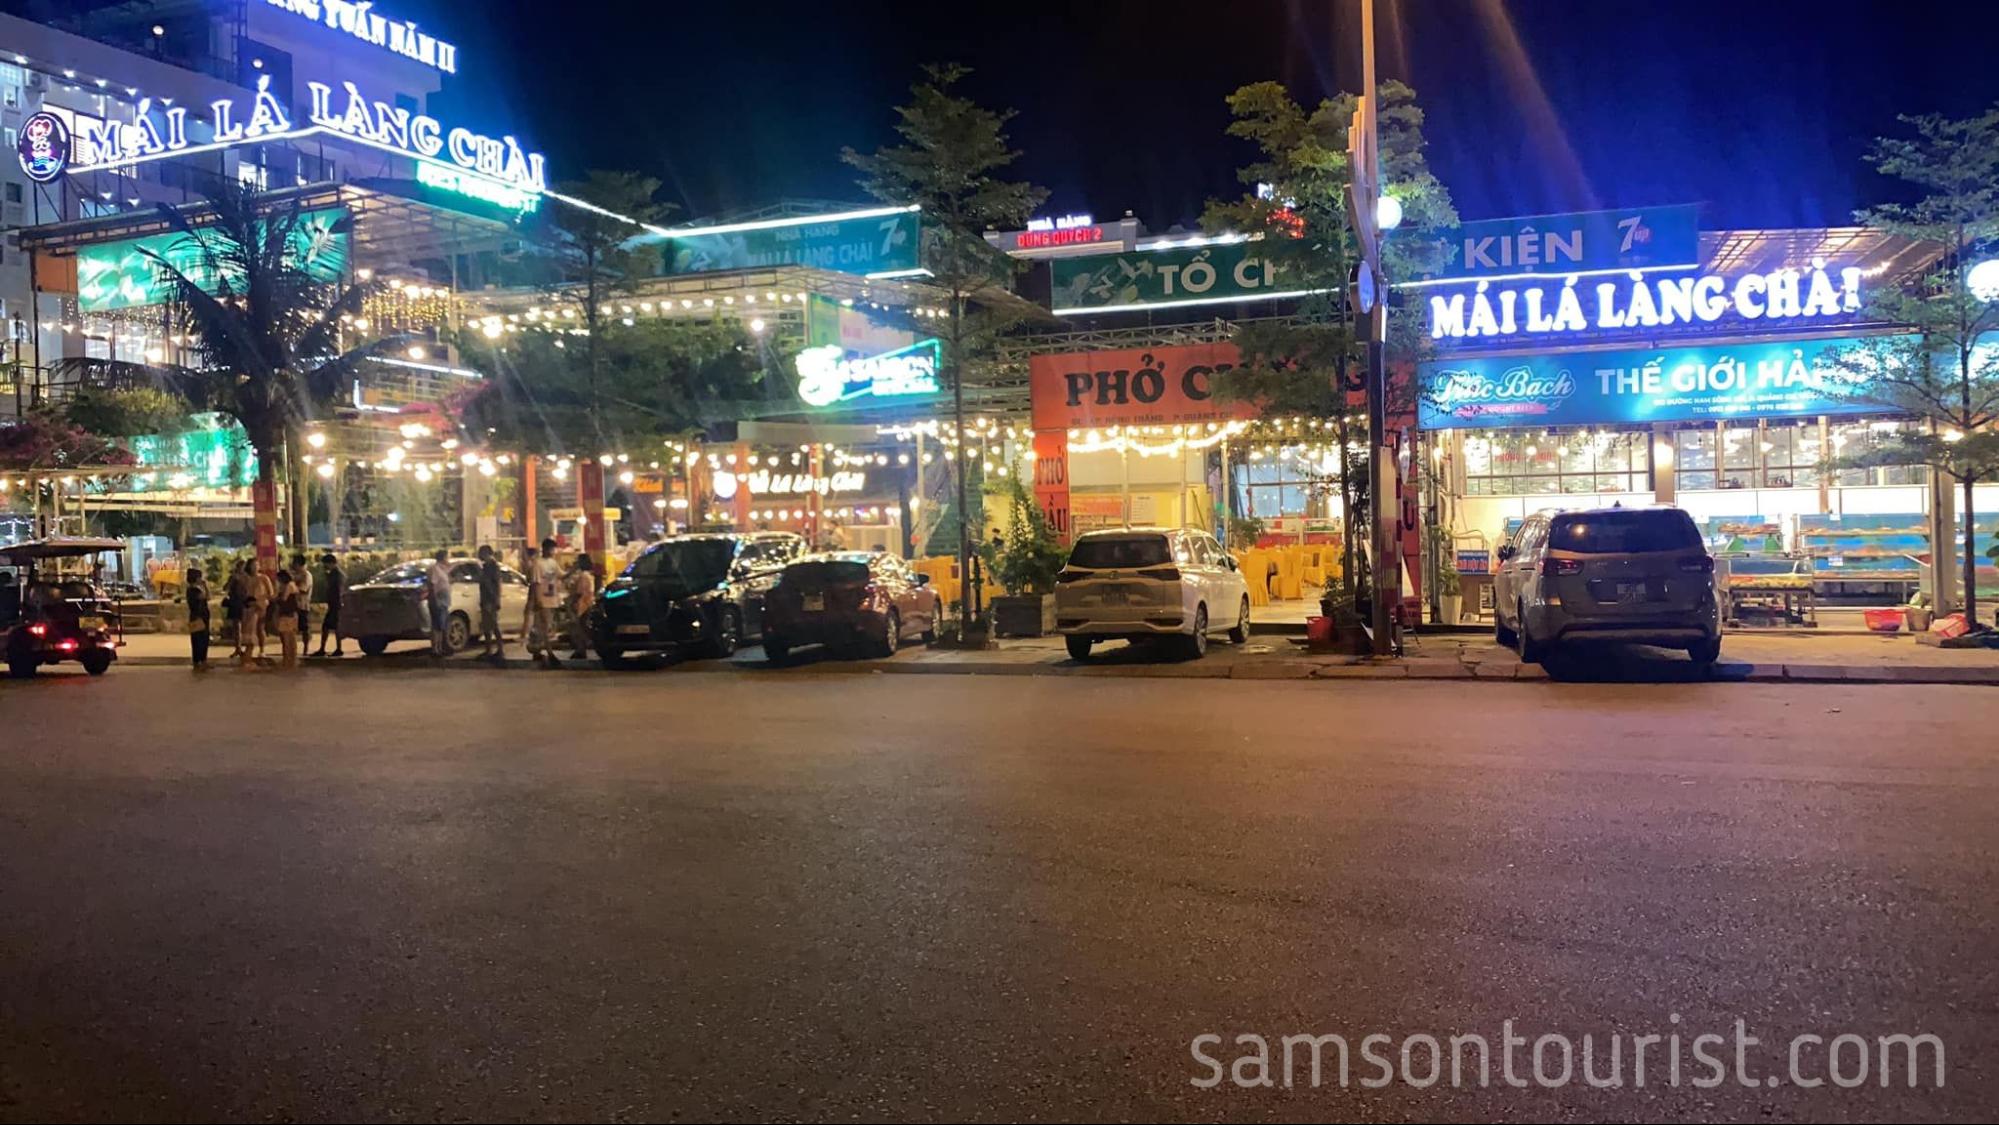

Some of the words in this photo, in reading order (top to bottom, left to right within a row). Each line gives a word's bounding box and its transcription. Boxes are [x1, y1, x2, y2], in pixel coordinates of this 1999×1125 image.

[86, 98, 187, 164] MÁI
[211, 75, 291, 142] LÁ
[307, 81, 443, 157] LÀNG
[1463, 226, 1584, 272] KIỆN
[1157, 250, 1217, 295] TỔ
[1430, 279, 1518, 339] MÁI
[1524, 274, 1588, 333] LÁ
[1596, 269, 1730, 328] LÀNG
[1065, 354, 1165, 406] PHỞ
[1495, 367, 1573, 400] Bạch
[1595, 356, 1665, 395] THẾ
[1670, 355, 1747, 393] GIỚI
